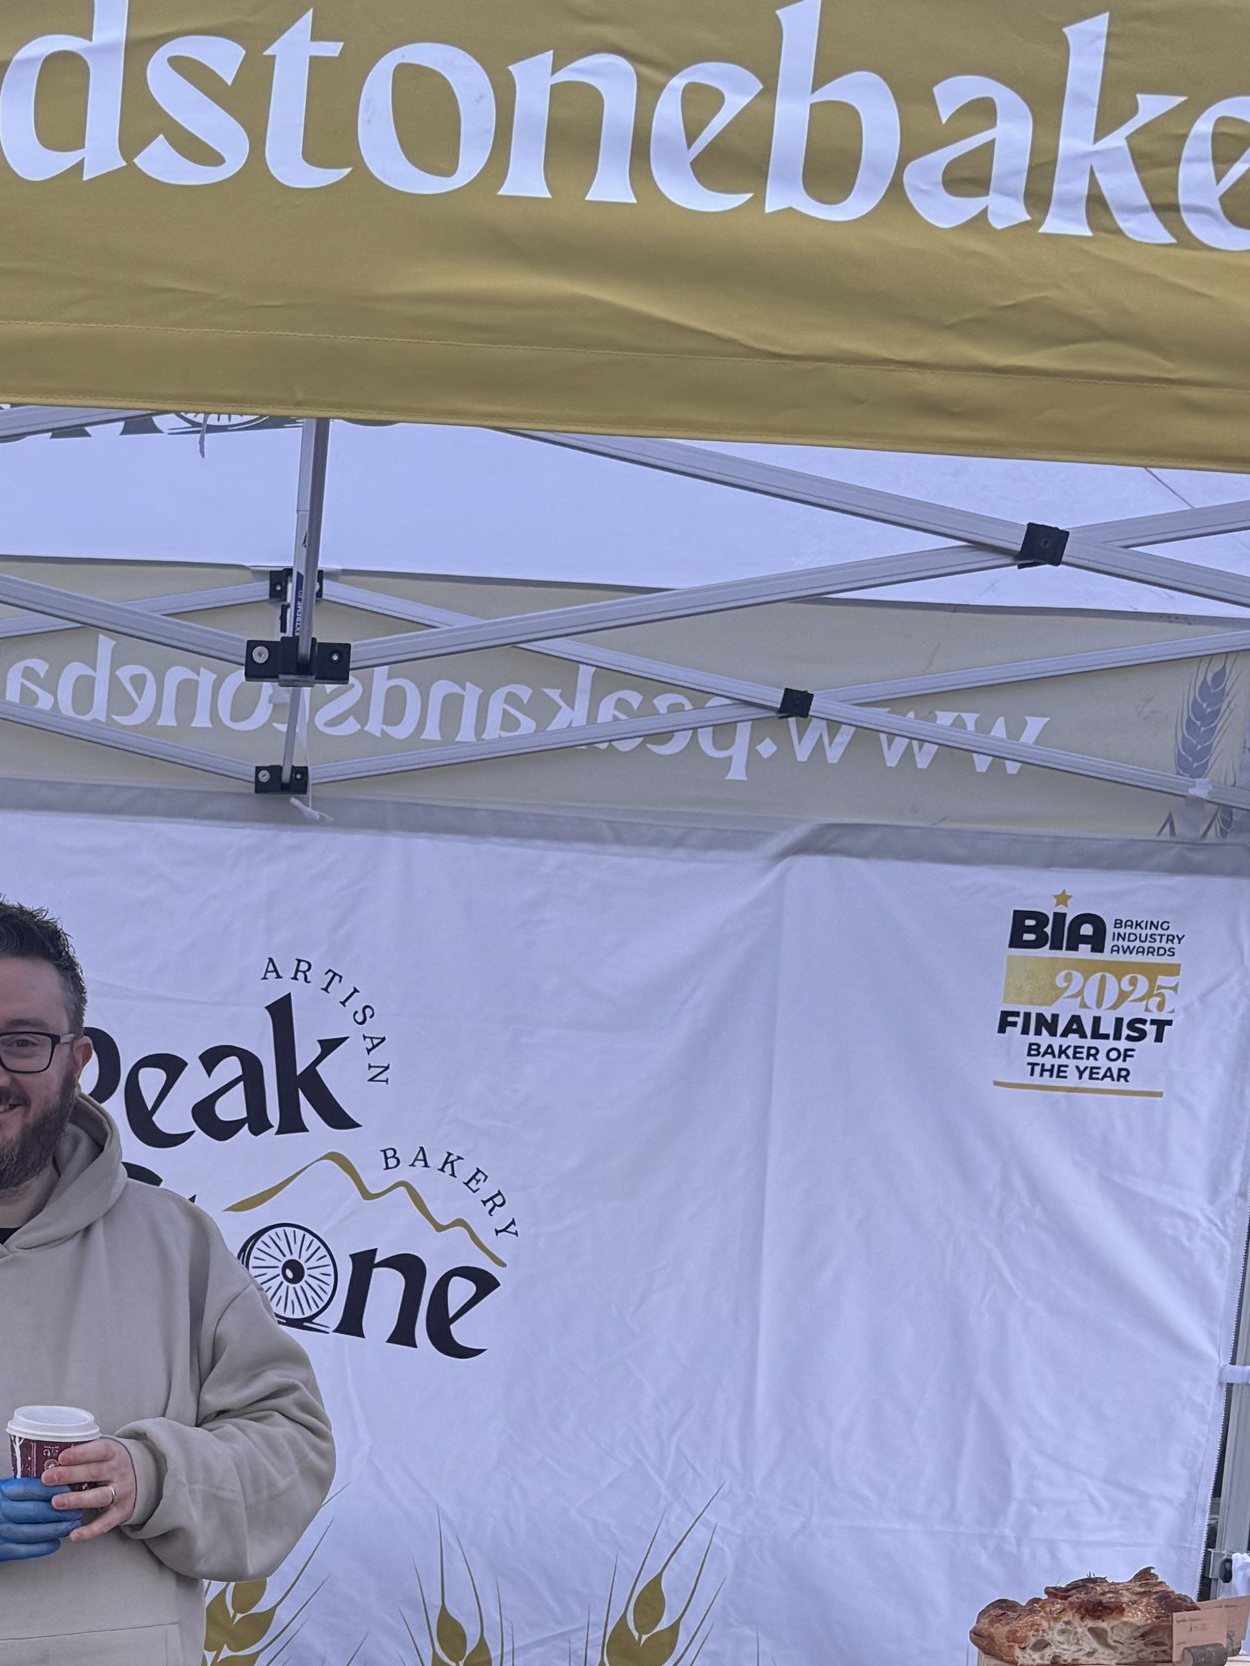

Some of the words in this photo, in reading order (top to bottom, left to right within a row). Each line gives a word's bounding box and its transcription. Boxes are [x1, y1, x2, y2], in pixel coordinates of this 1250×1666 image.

[1008, 909, 1107, 954] BIA
[1112, 931, 1186, 945] INDUSTRY
[1113, 918, 1170, 931] BAKING
[1110, 944, 1176, 957] AWARDS
[1052, 969, 1181, 1013] 2025
[260, 956, 391, 1086] ARTISAN
[997, 1010, 1173, 1043] FINALIST
[1026, 1042, 1099, 1061] BAKER
[1105, 1047, 1136, 1063] OF
[1026, 1062, 1069, 1079] THE
[1075, 1065, 1131, 1083] YEAR
[380, 1145, 519, 1242] BAKERY
